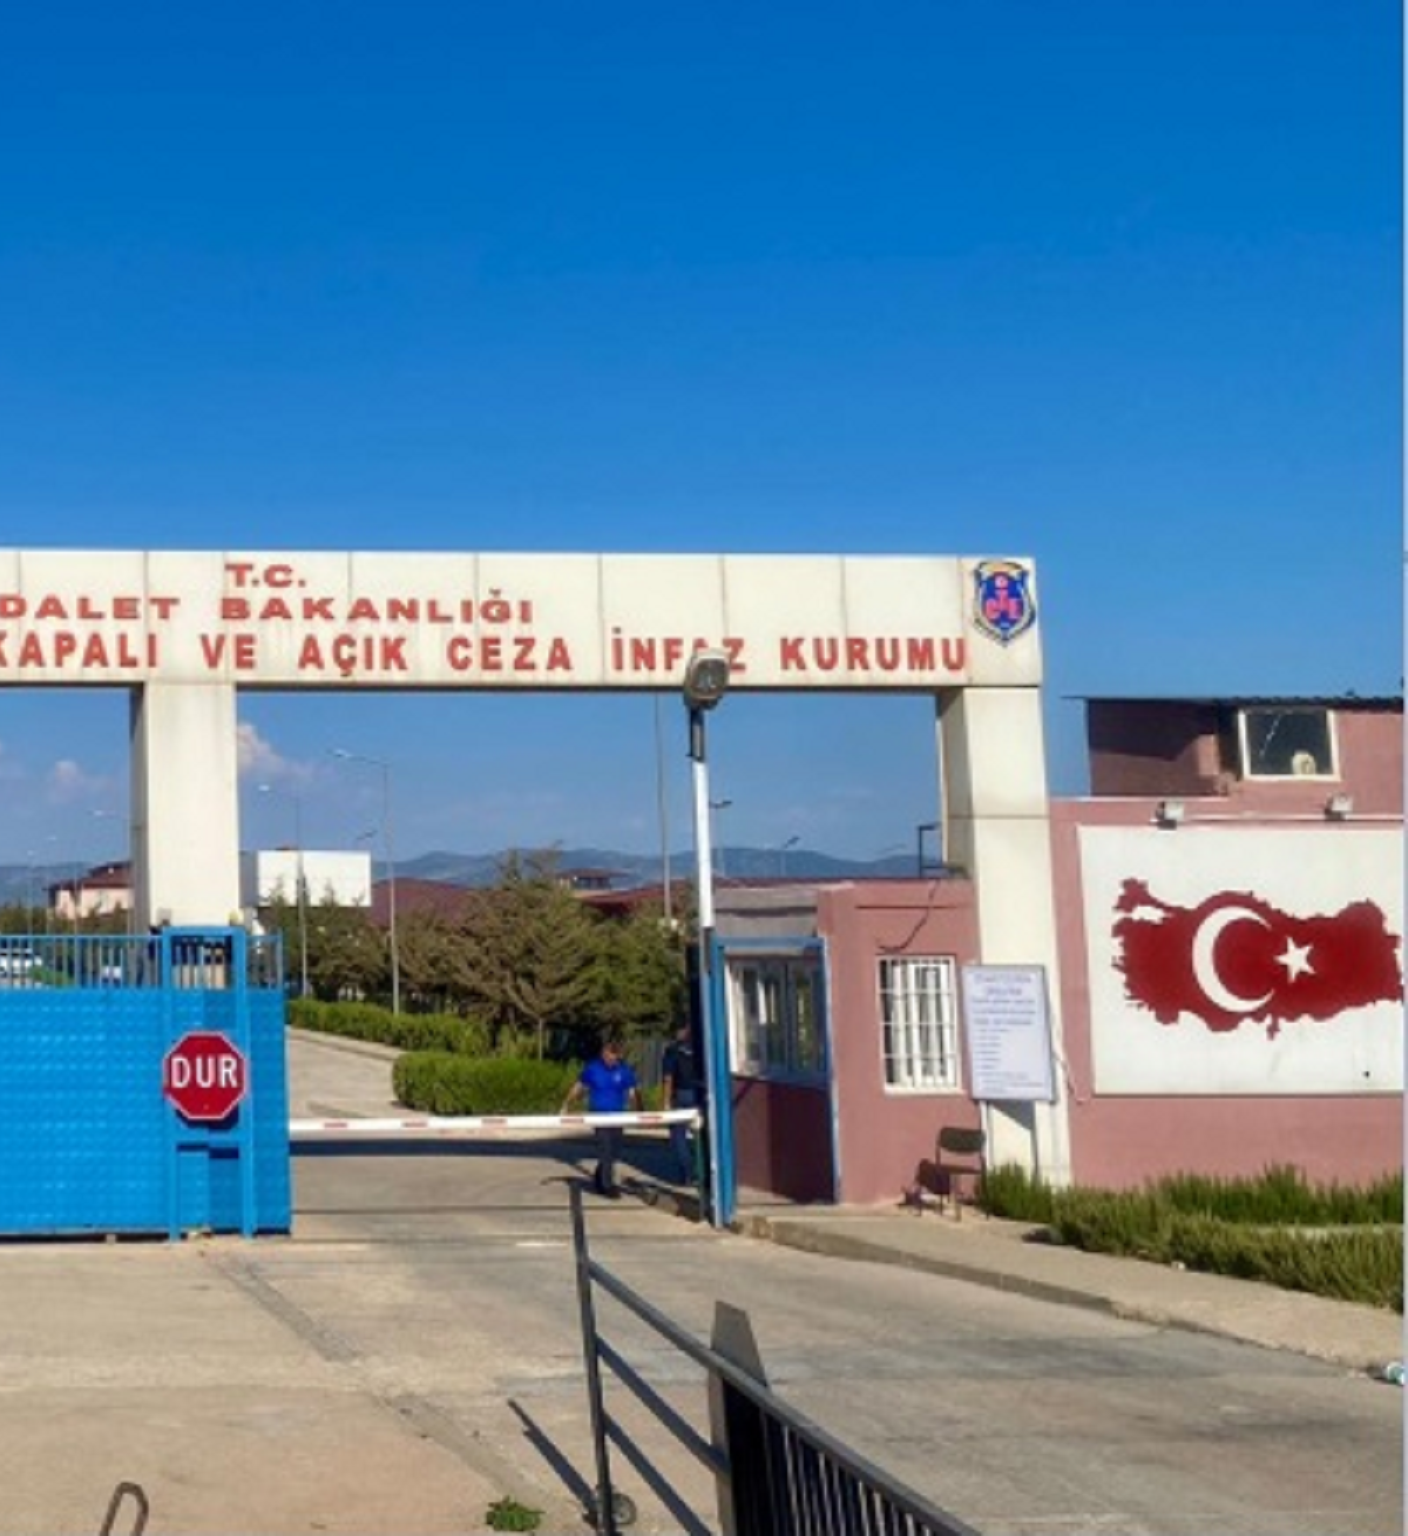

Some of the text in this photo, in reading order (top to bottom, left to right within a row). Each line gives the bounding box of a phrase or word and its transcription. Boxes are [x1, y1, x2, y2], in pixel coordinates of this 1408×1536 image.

[224, 562, 307, 588] T.C.
[219, 588, 534, 624] BAKANLIĞI
[199, 634, 257, 670] VE
[296, 634, 408, 678] AÇIK
[445, 635, 574, 672] CEZA
[778, 636, 968, 672] KURUMU
[170, 1053, 238, 1089] DUR
